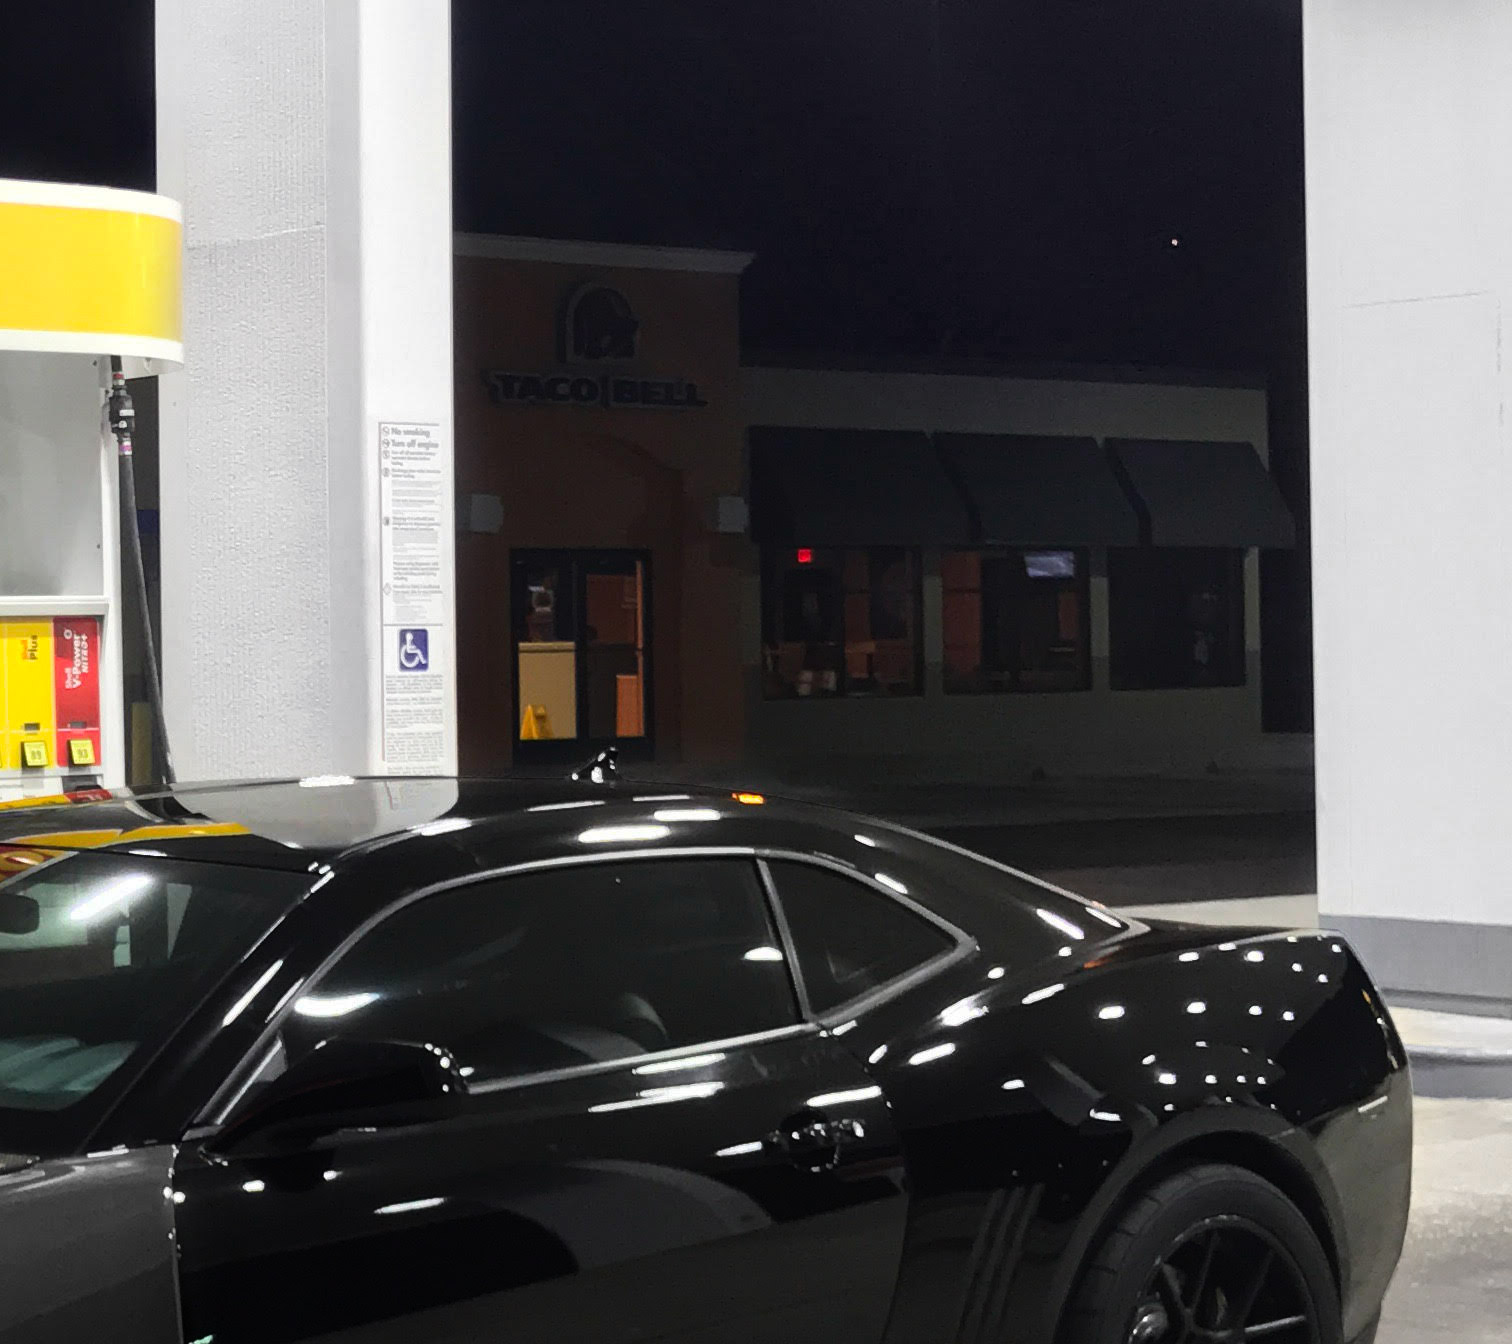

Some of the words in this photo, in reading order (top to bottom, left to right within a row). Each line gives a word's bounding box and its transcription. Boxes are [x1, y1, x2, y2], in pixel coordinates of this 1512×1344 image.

[493, 372, 599, 403] TACO
[612, 378, 707, 407] BELL
[29, 635, 38, 660] Plus
[72, 633, 82, 689] V-Power
